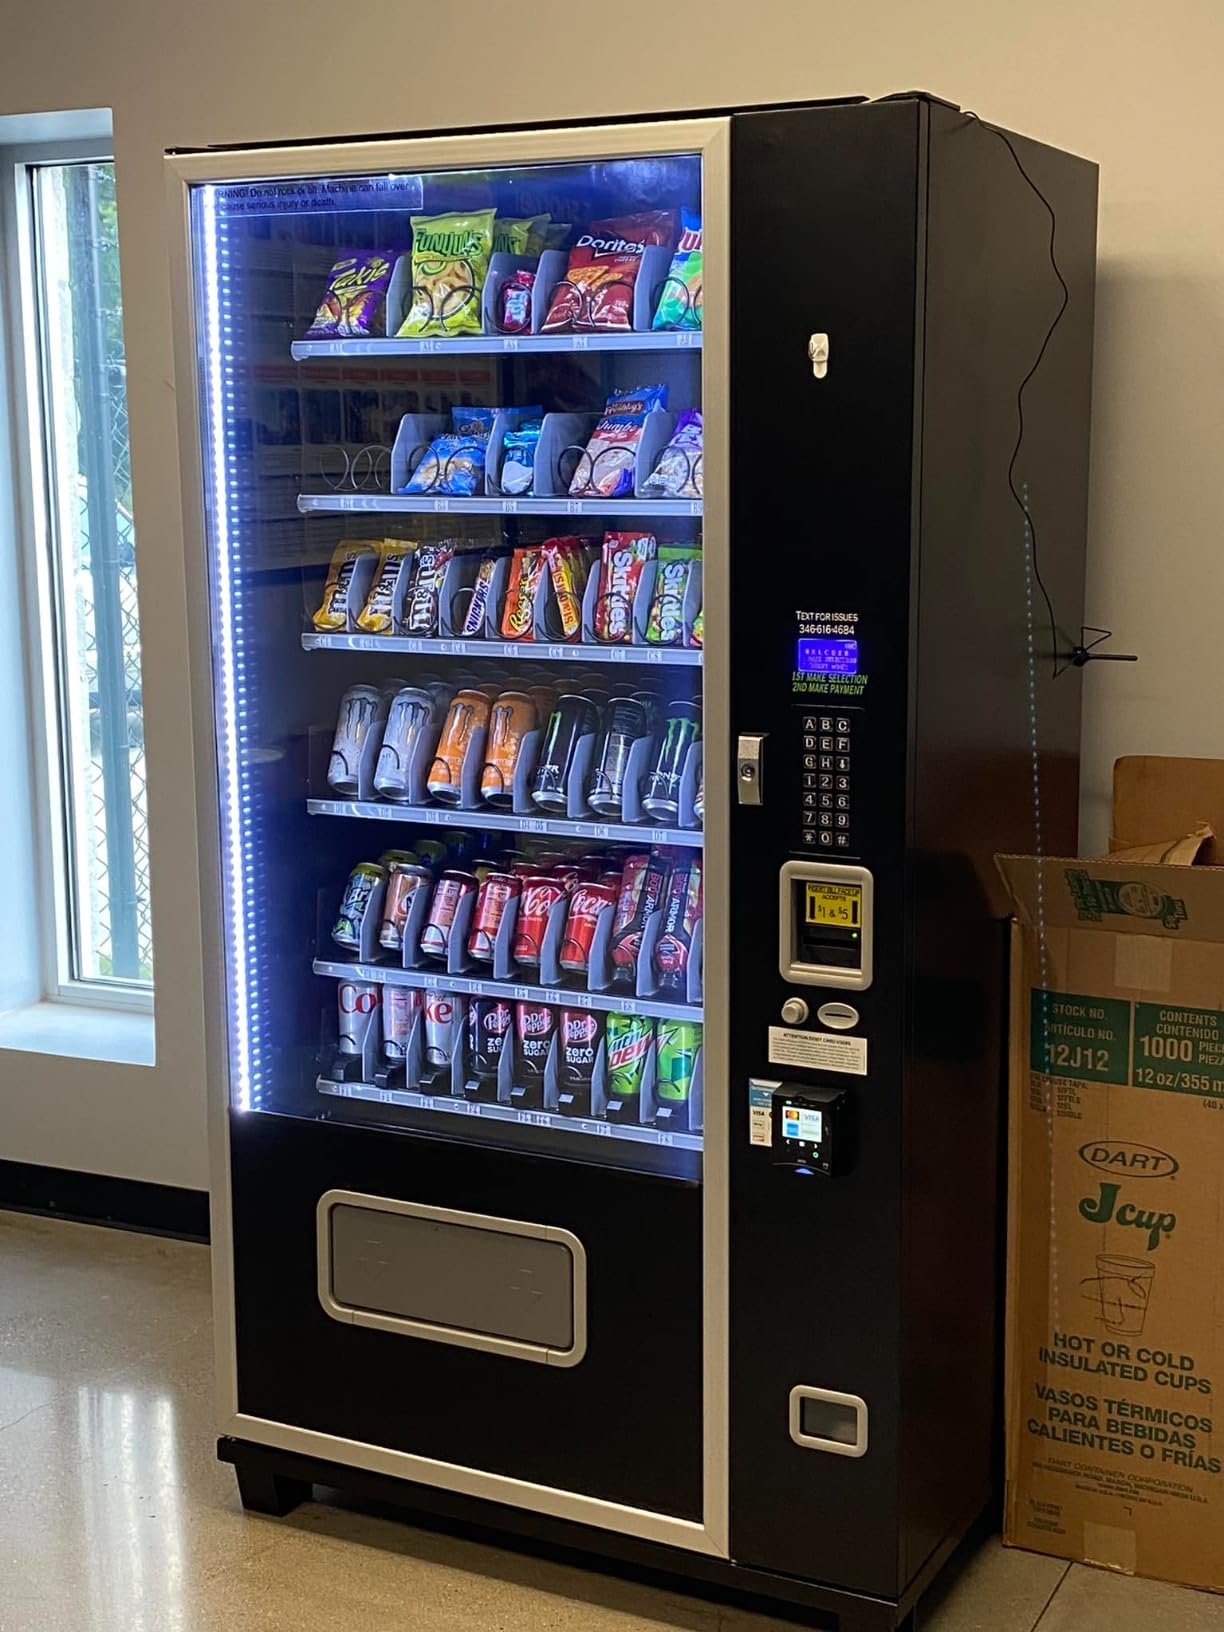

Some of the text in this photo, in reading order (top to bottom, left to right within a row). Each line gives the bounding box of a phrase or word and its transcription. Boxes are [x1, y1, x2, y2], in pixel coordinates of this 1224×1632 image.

[466, 581, 490, 632] SNICKERS
[795, 610, 859, 622] TEXT FOR ISSUES
[806, 673, 827, 683] MAKE
[828, 674, 868, 685] SELECTION
[792, 682, 865, 696] 2ND MAKE PAYMENT
[805, 719, 847, 732] A B C
[805, 738, 814, 748] D
[821, 739, 830, 750] E
[805, 756, 830, 769] G H
[821, 776, 830, 788] 2
[838, 777, 848, 789] 3
[804, 794, 847, 808] 4 5 6
[820, 814, 830, 825] 8
[838, 815, 846, 826] 9
[829, 909, 836, 918] &
[1053, 1003, 1087, 1017] STOCK
[1160, 1010, 1217, 1027] CONTENTS
[1156, 1023, 1220, 1041] CONTENIDO
[566, 1047, 594, 1057] zero
[1140, 1035, 1193, 1062] 1000
[1135, 1067, 1154, 1084] 12
[1156, 1071, 1210, 1092] oz/355
[1090, 1148, 1167, 1171] DART
[1054, 1332, 1195, 1371] HOT OR COLD
[1039, 1346, 1212, 1395] INSULATED CUPS
[1034, 1382, 1213, 1434] VASOS TÉRMICOS
[1048, 1406, 1197, 1450] PARA BEBIDAS
[1027, 1417, 1222, 1473] CALIENTES O FRÍAS
